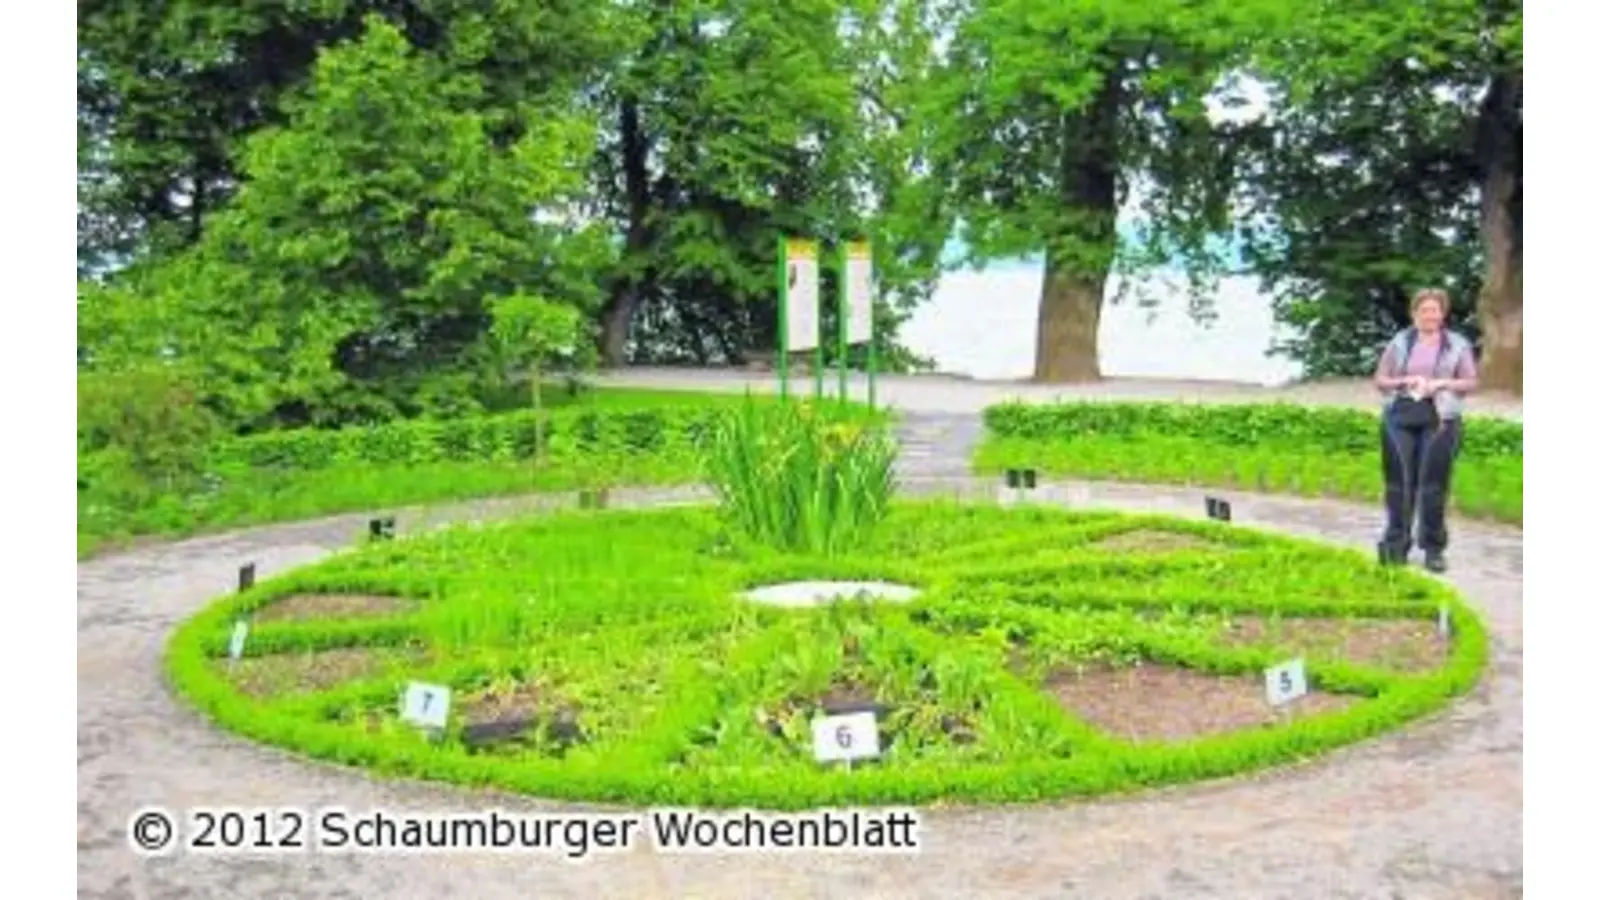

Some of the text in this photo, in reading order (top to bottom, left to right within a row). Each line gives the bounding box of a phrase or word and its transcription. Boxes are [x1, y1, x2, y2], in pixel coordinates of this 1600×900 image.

[1279, 670, 1293, 693] 5
[419, 690, 435, 715] 7
[835, 724, 853, 749] 6
